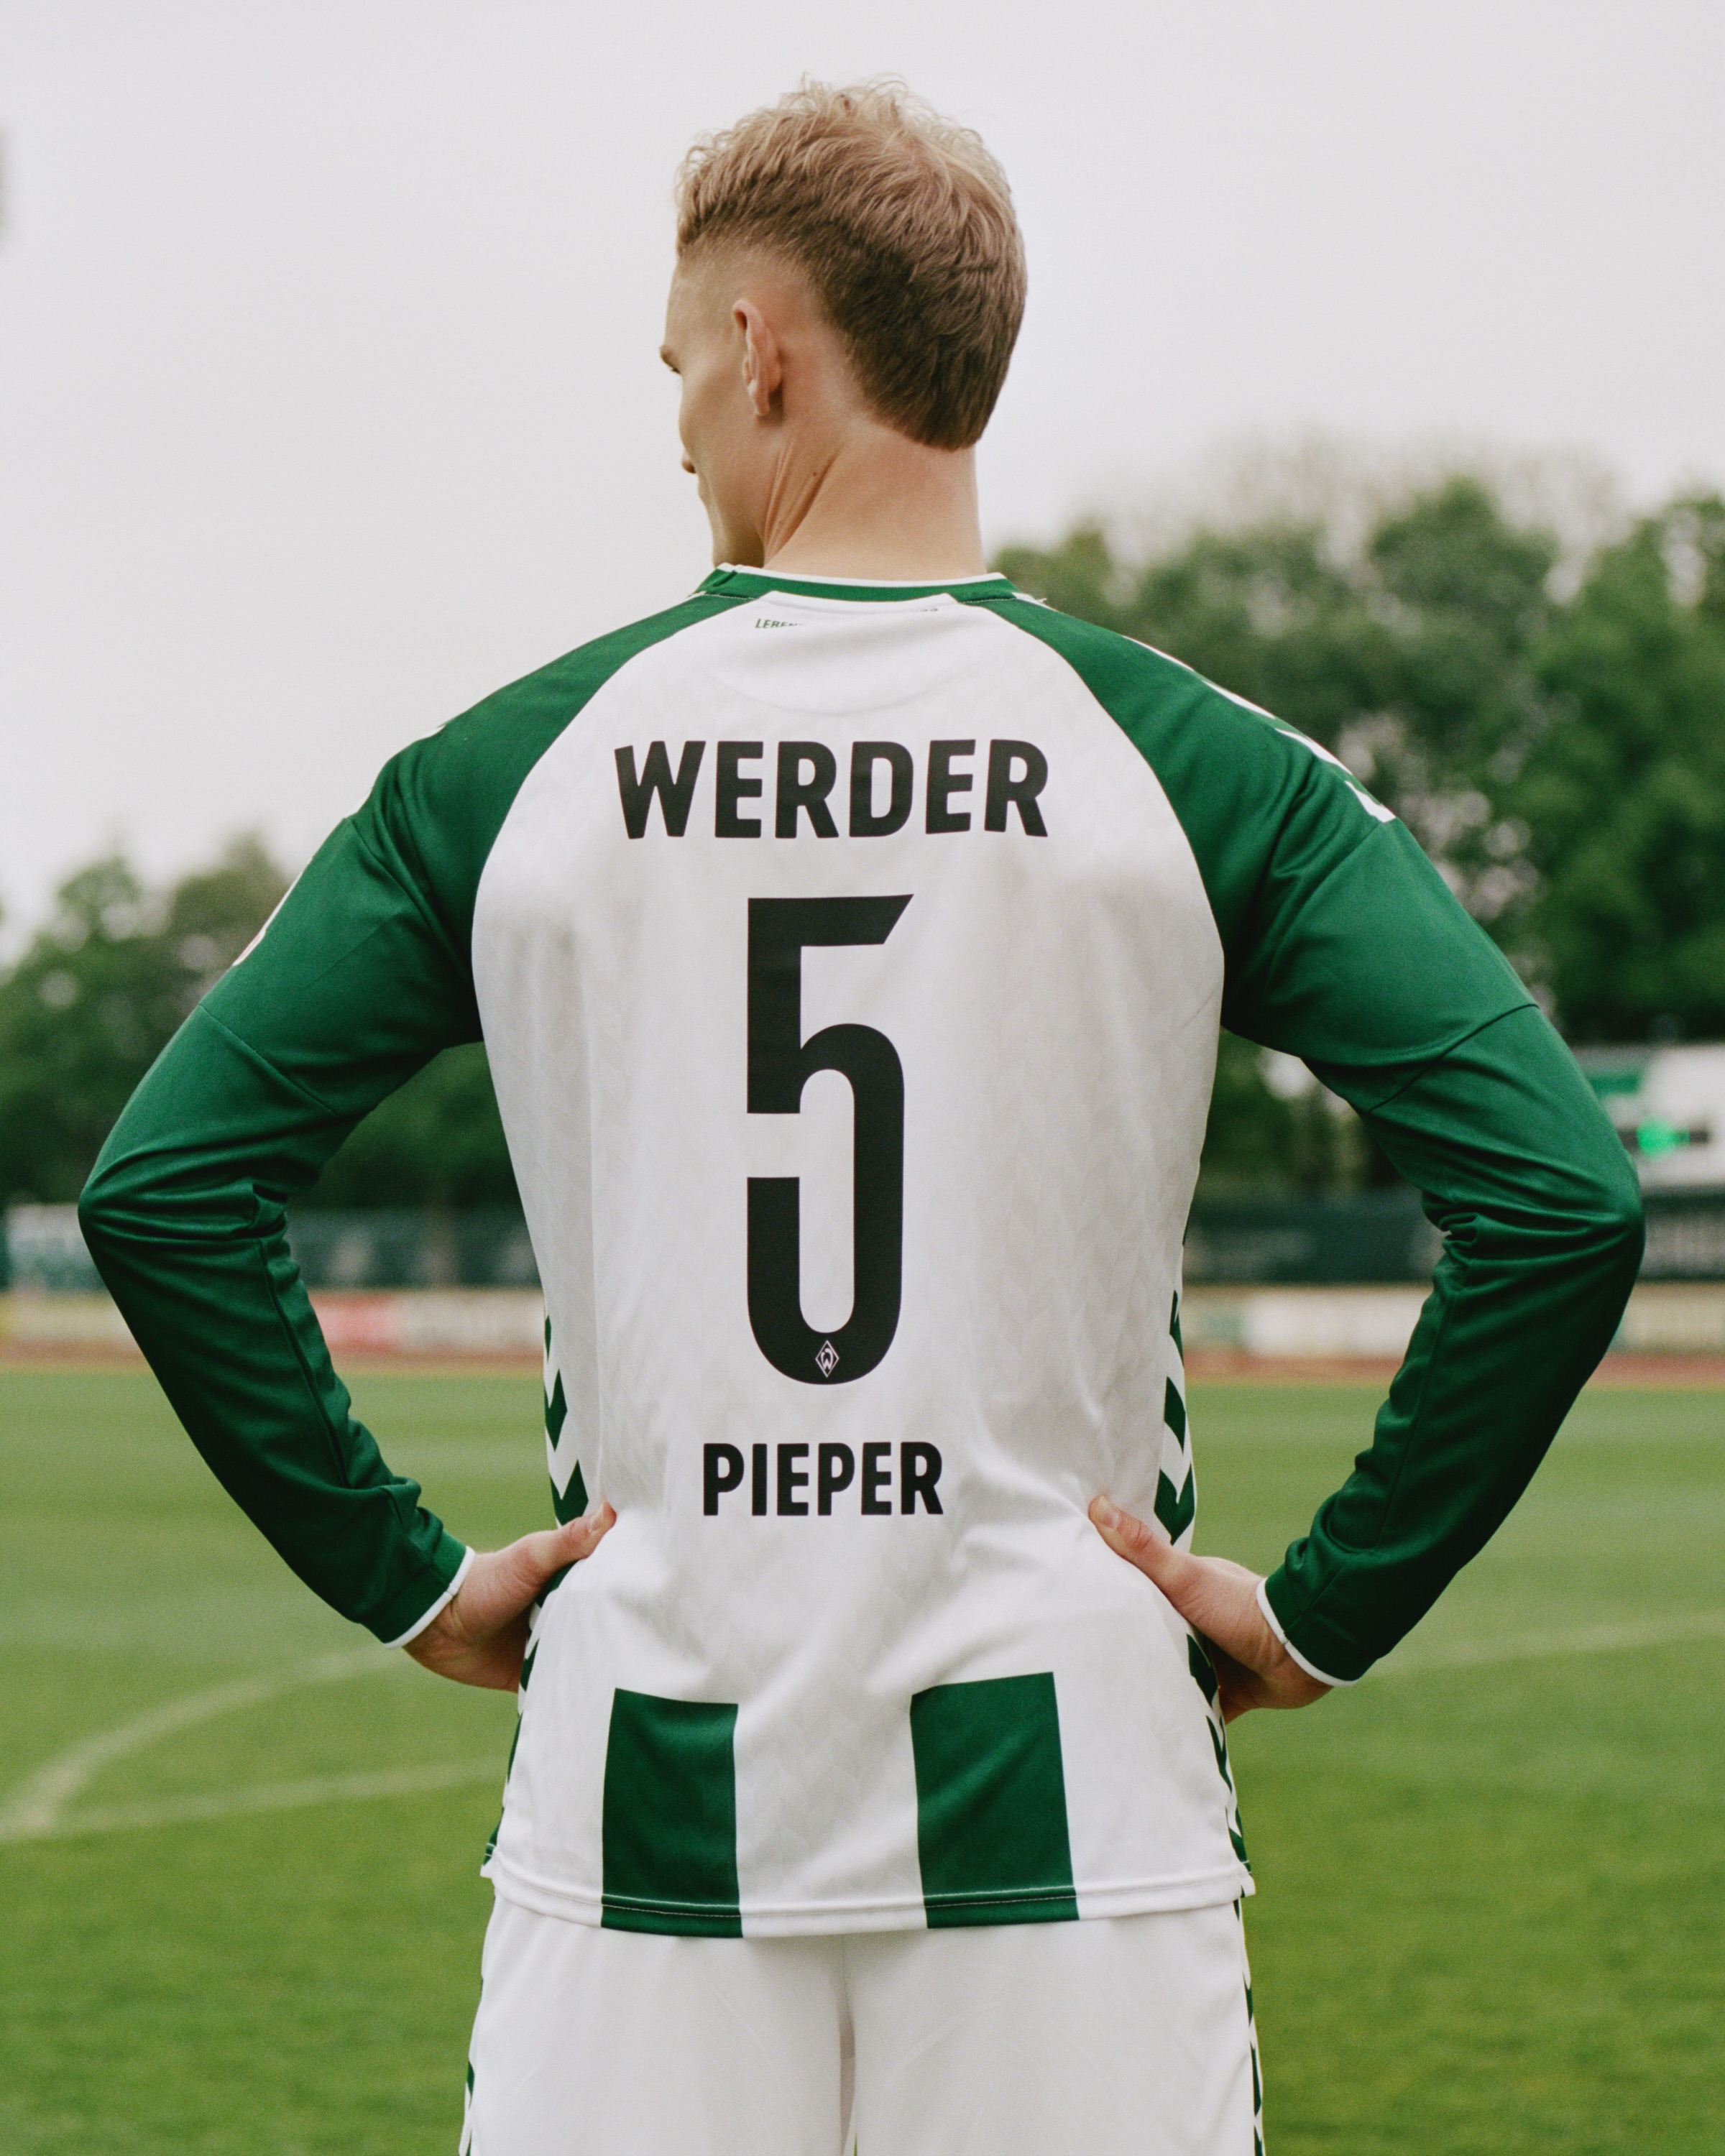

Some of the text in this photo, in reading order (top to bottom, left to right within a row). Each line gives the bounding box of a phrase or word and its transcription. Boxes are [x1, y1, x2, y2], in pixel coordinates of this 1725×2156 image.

[615, 739, 1049, 839] WERDER
[747, 894, 914, 1385] 5
[703, 1442, 944, 1516] PIEPER
